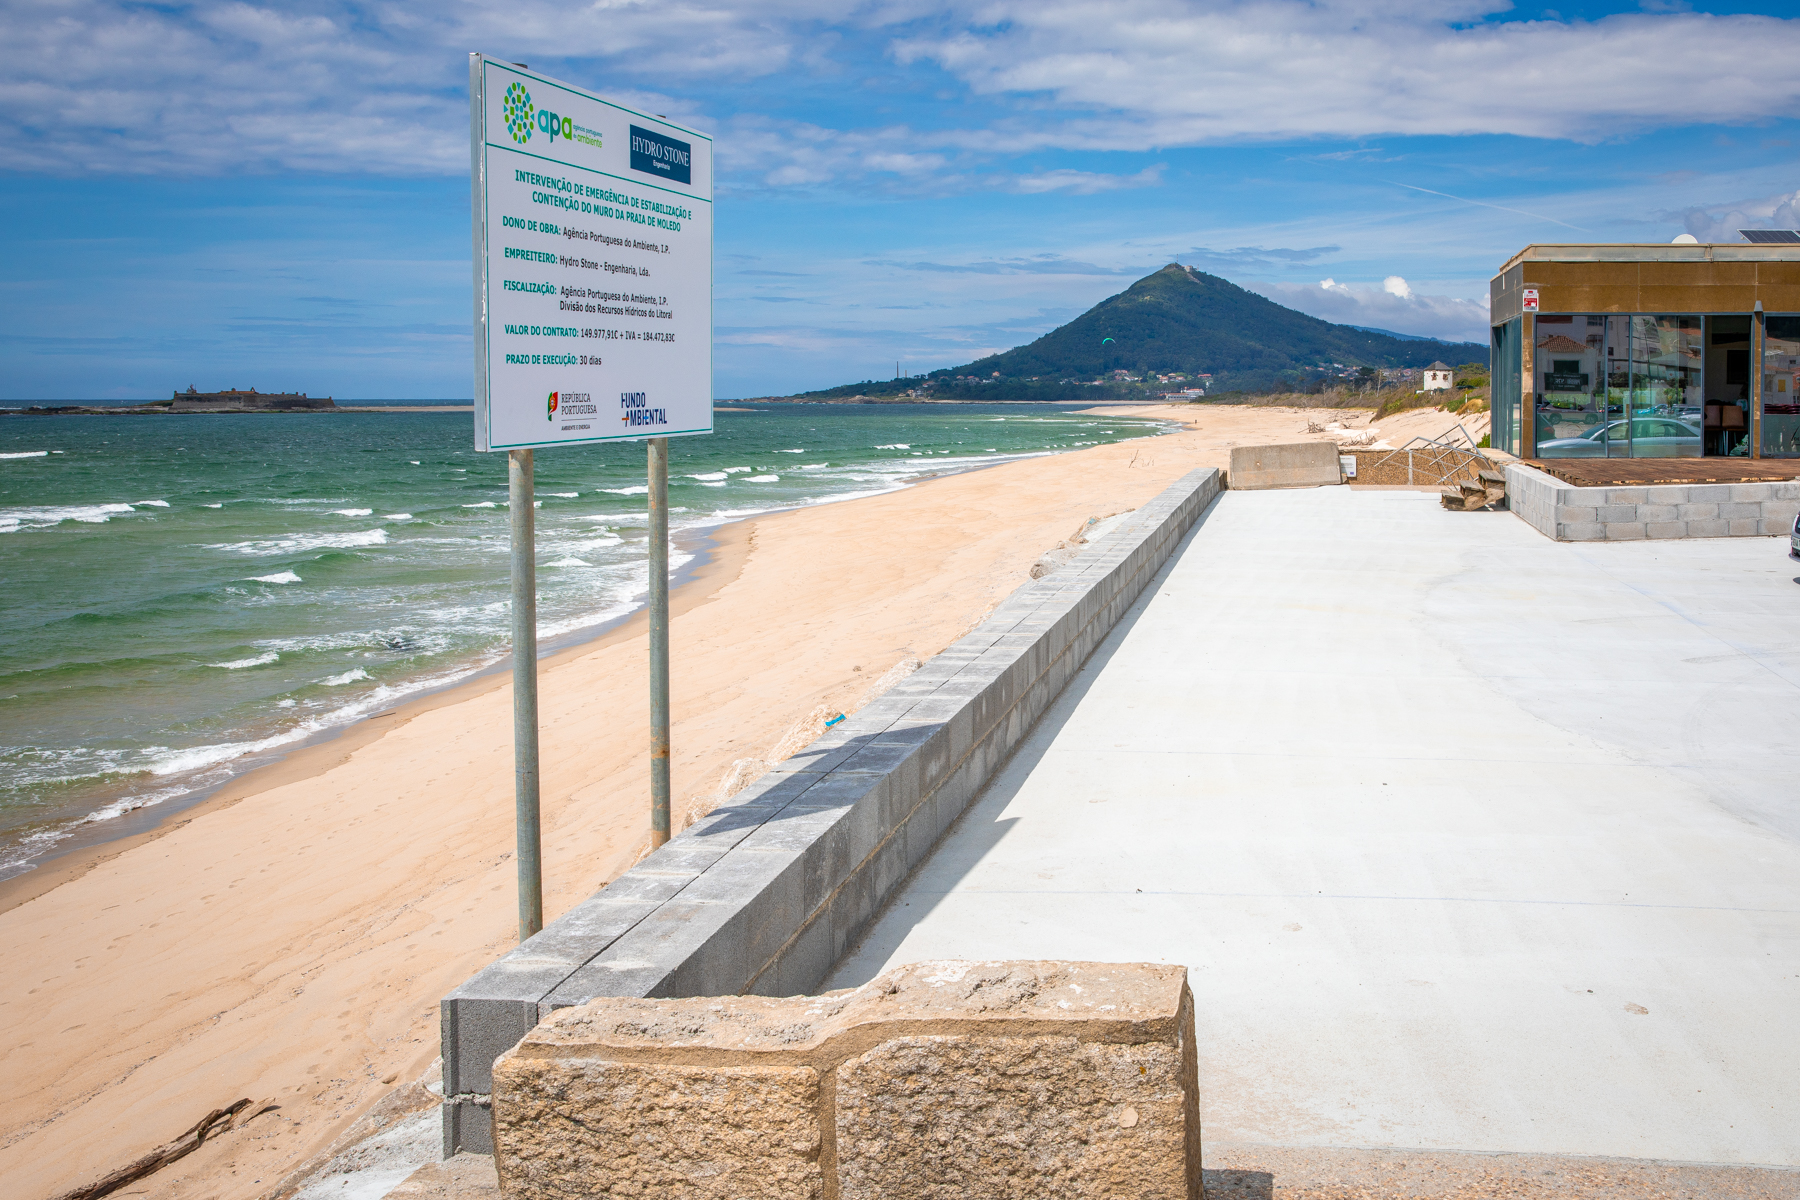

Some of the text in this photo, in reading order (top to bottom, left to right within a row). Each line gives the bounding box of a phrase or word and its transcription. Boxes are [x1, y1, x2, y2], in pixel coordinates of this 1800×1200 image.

[538, 109, 572, 143] apa
[576, 134, 602, 148] ambiente
[632, 135, 690, 166] HYDRO STONE
[515, 169, 692, 220] INTERVENÇÃO DE EMERGÊNCIA DE ESTABILIZAÇÃO E
[532, 191, 681, 232] CONTENÇÃO DO MURO DA PRAIA DE MOLEDO
[502, 216, 670, 254] DONO DE OBRA: Agência Portuguesa do Ambiente, I.P.
[504, 247, 558, 264] EMPREITEIRO:
[560, 254, 580, 268] Hydro
[580, 258, 598, 270] Stone
[604, 262, 638, 277] Engenharia,
[638, 266, 651, 276] Lda.
[504, 280, 668, 306] FISCALIZAÇÃO: Agência Portuguesa do Ambiente, I.P.
[560, 300, 673, 319] Divisão dos Recursos Hídricos do Litoral
[504, 324, 528, 335] VALOR
[530, 326, 540, 336] DO
[542, 326, 579, 338] CONTRATO:
[580, 328, 618, 340] 149.977,91€
[625, 330, 636, 340] IVA
[506, 352, 602, 367] PRAZO DE EXECUÇÃO: 30 dias
[561, 391, 591, 403] REPÚBLICA
[620, 392, 646, 408] FUNDO
[561, 404, 598, 415] PORTUGUESA
[622, 408, 668, 428] AMBIENTAL
